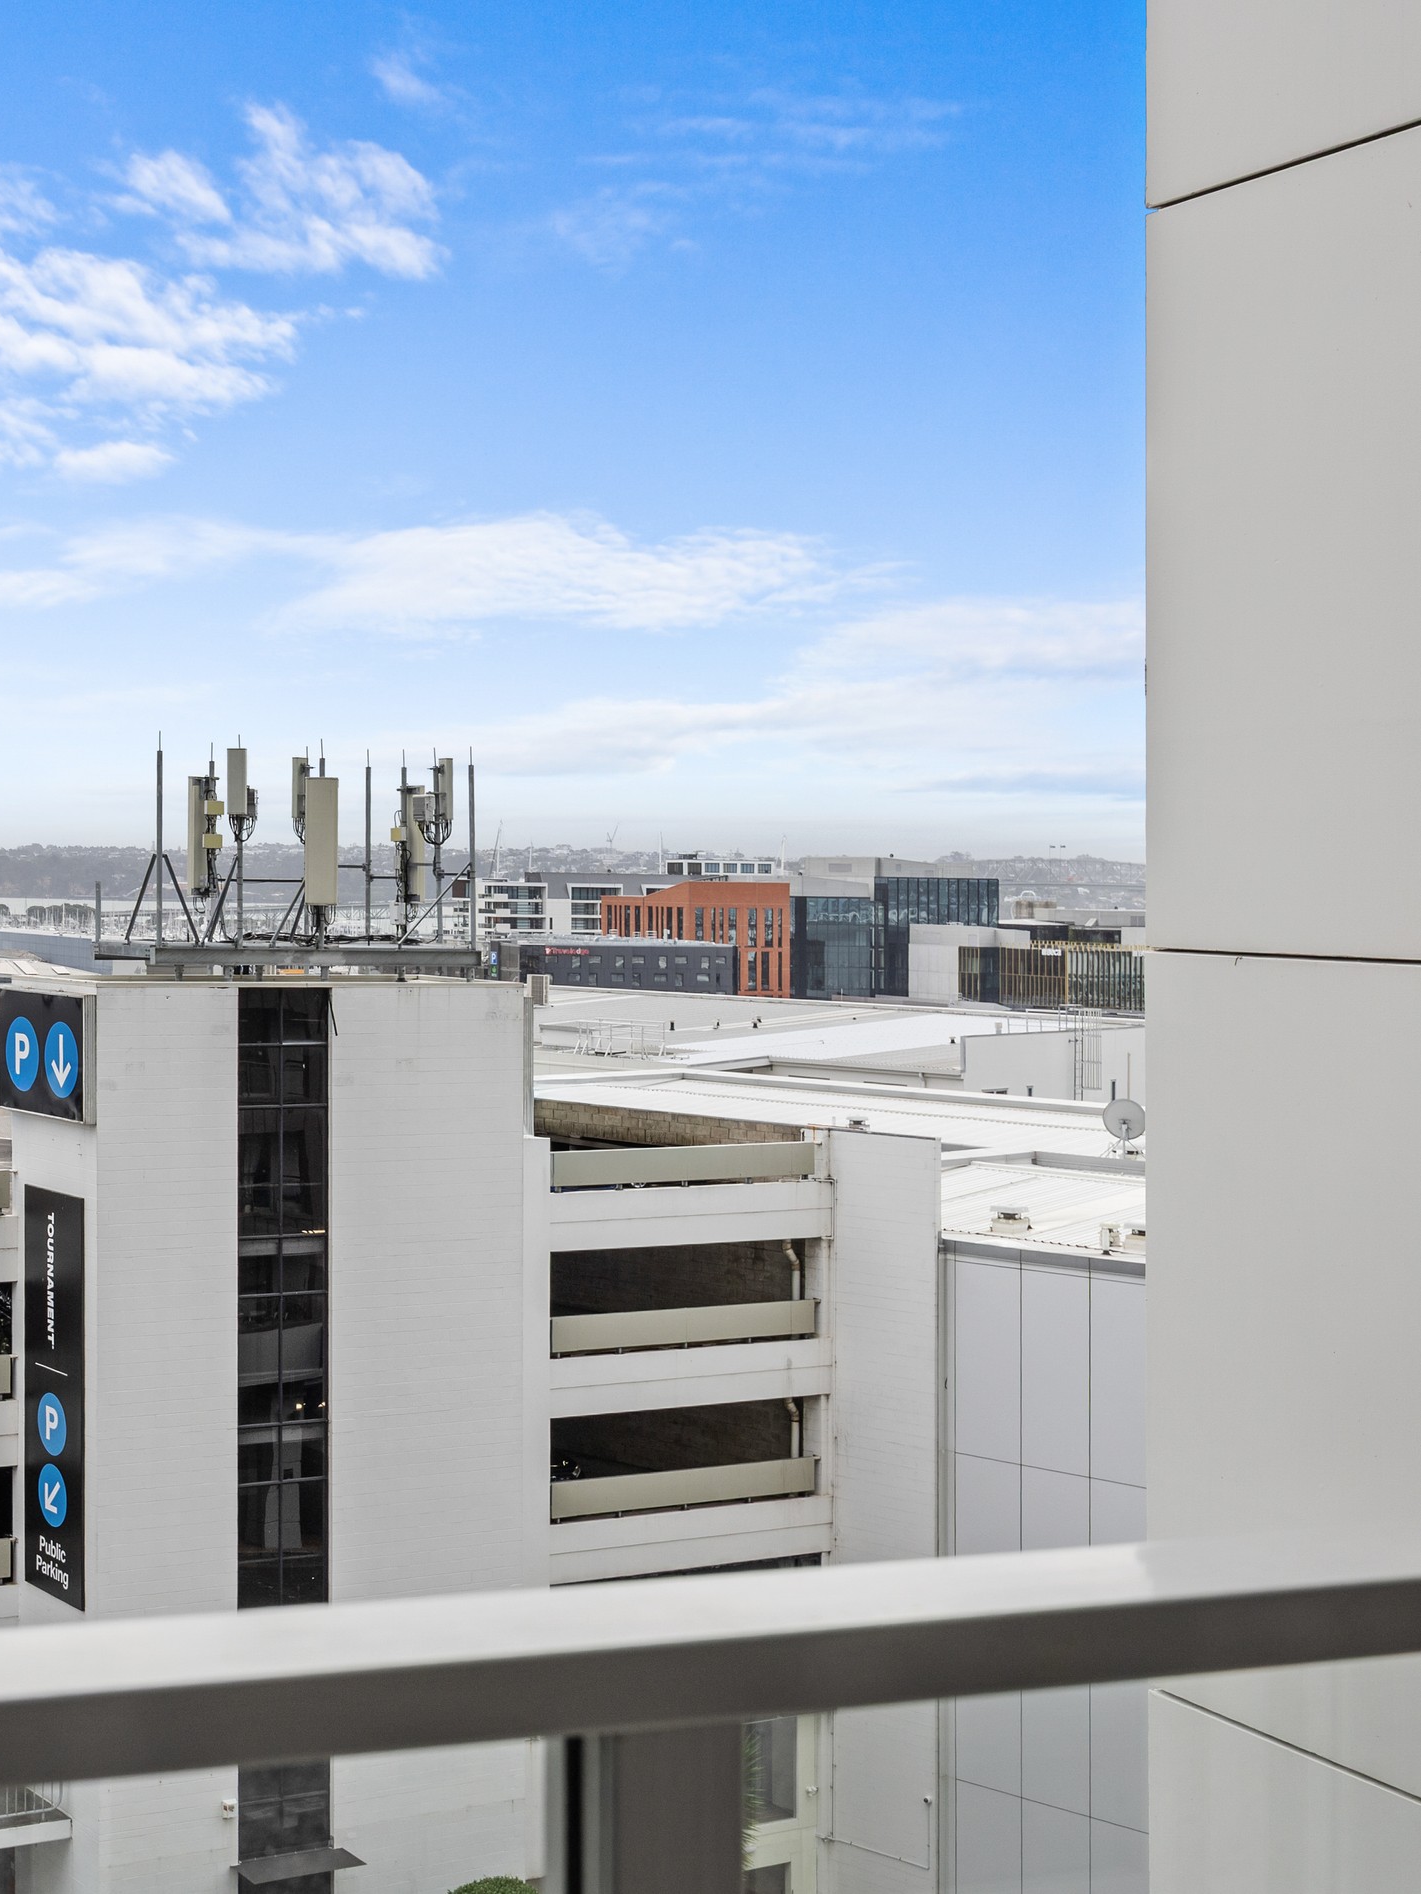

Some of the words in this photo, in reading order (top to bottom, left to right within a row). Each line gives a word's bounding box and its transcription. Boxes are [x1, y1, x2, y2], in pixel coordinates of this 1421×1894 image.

[14, 1032, 30, 1075] P
[46, 1212, 55, 1349] TOURNAMENT
[45, 1405, 59, 1440] P
[39, 1535, 66, 1563] Public
[35, 1554, 69, 1590] Parking
